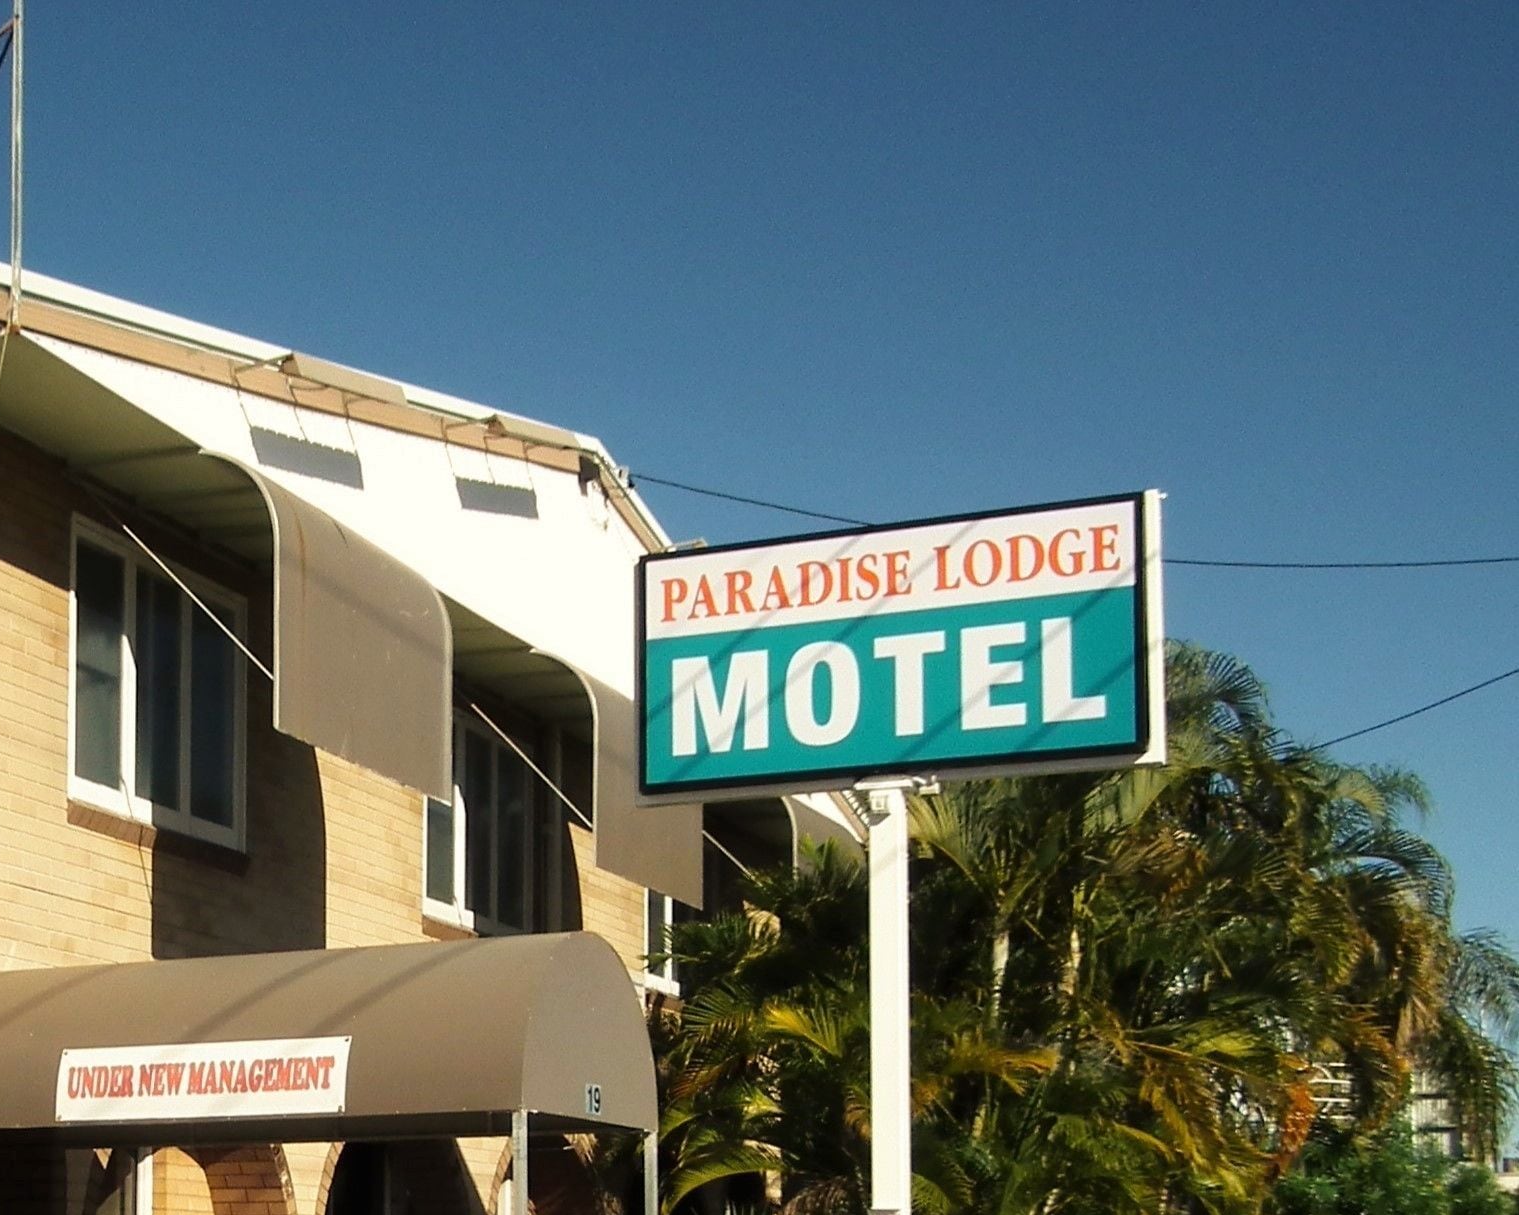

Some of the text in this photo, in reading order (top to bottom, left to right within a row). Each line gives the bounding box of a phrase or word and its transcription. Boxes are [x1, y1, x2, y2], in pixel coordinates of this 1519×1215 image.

[661, 524, 1121, 623] PARADISE LODGE
[672, 616, 1107, 758] MOTEL
[67, 1056, 335, 1099] UNDER NEW MANAGEMENT
[588, 1085, 601, 1113] 19
